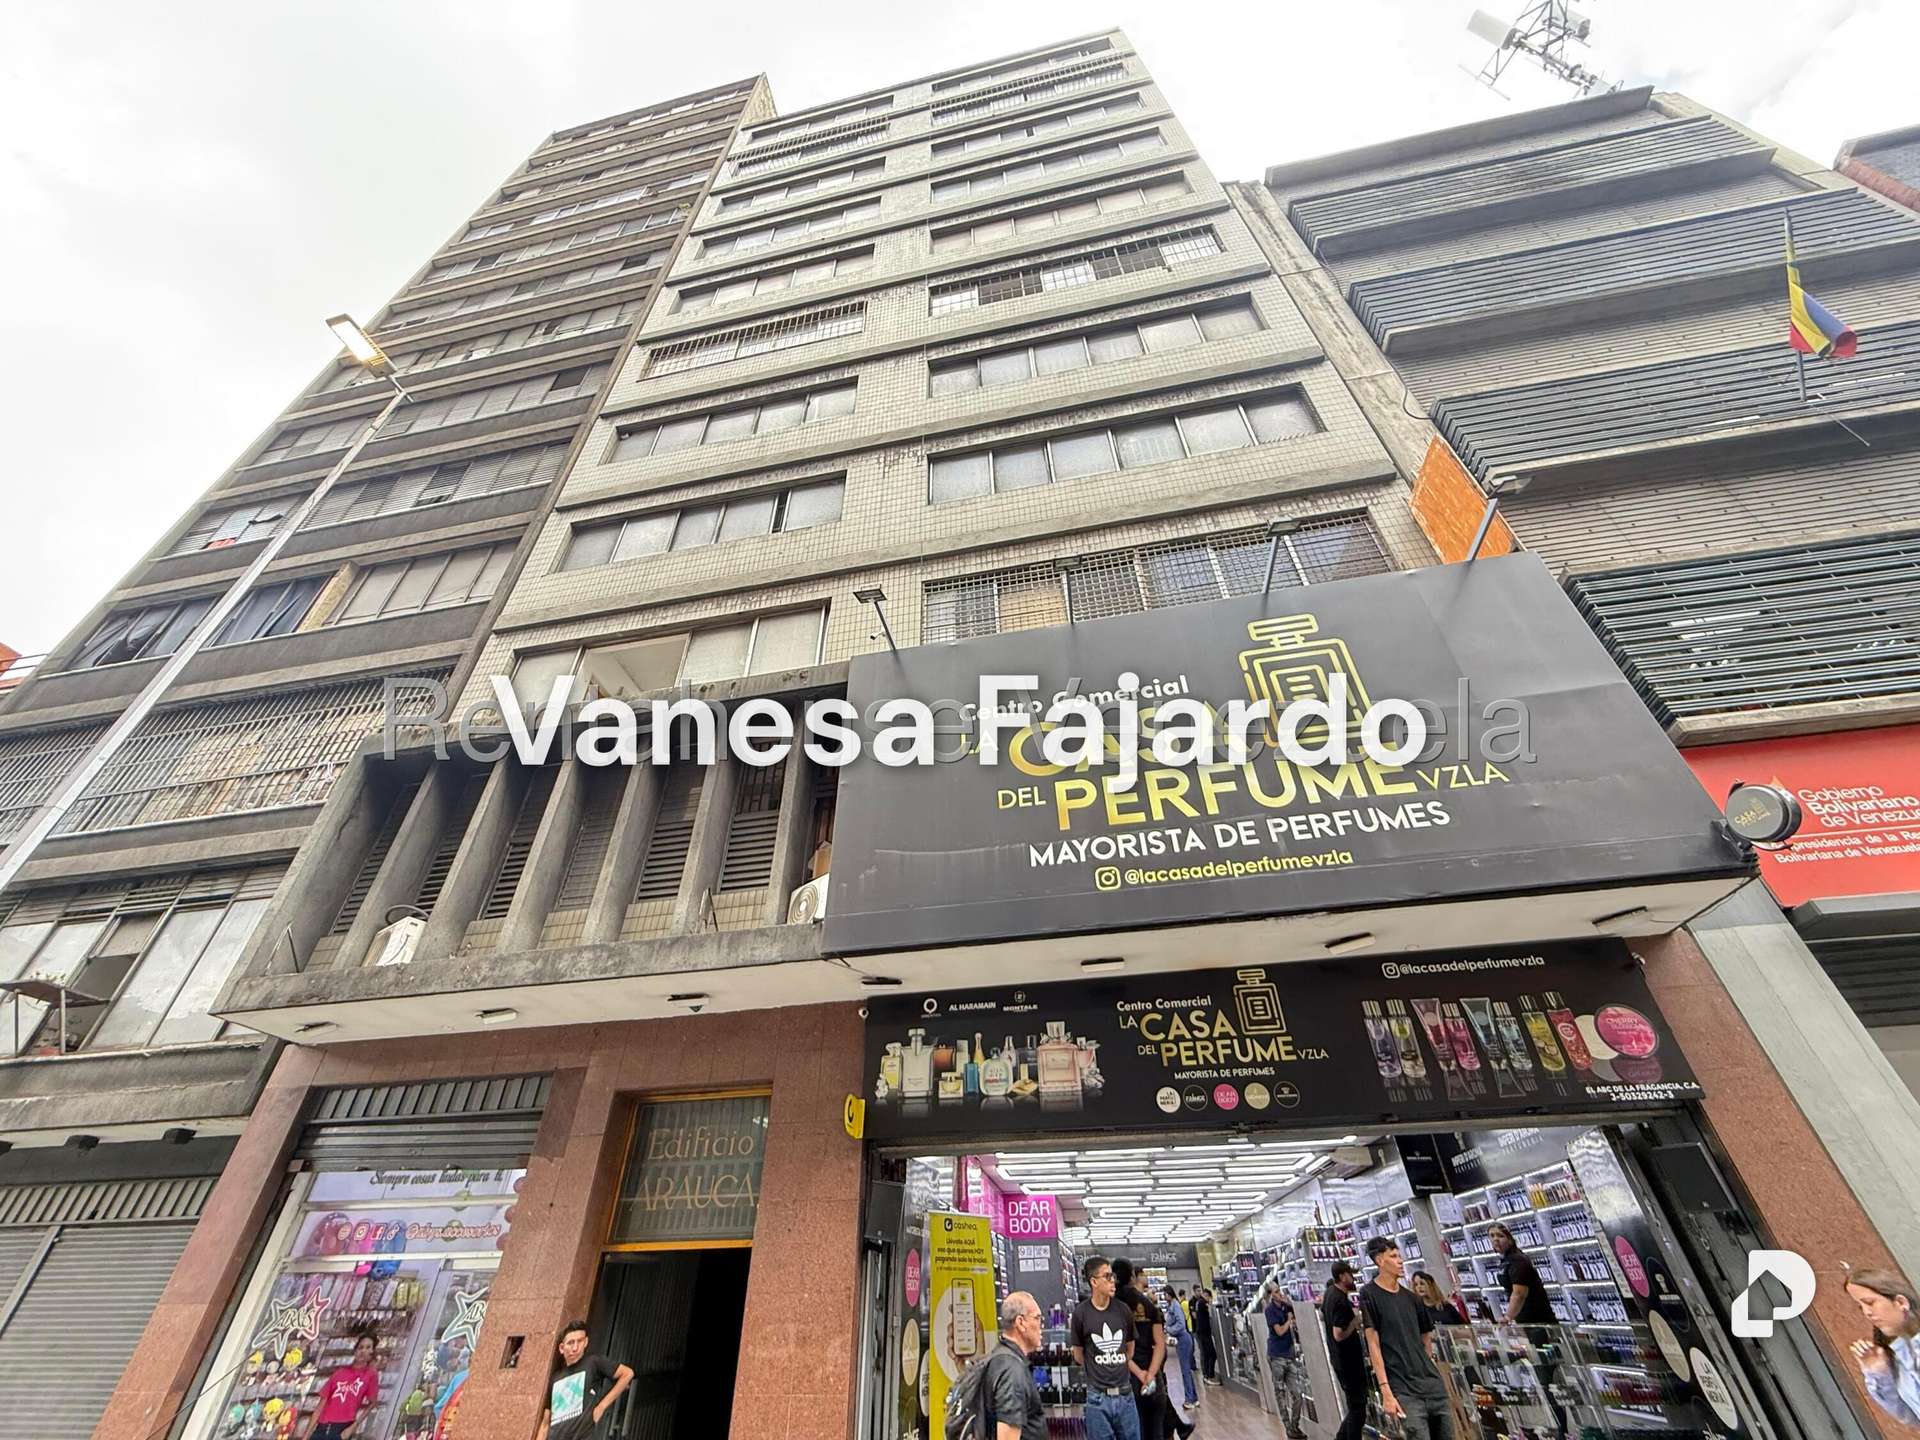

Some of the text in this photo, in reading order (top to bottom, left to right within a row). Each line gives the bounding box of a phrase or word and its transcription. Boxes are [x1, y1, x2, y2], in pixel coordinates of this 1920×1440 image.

[1052, 674, 1190, 710] Comercial
[996, 740, 1510, 831] DEL PERFUME VZLA
[1797, 785, 1883, 802] Gobierno
[1806, 796, 1920, 816] Bolivariano
[1820, 813, 1847, 828] de
[1029, 801, 1451, 867] MAYORISTA DE PERFUMES
[1864, 834, 1883, 844] de
[1883, 832, 1899, 842] la
[1774, 849, 1844, 864] Bolivariana
[1843, 847, 1862, 857] de
[1124, 849, 1354, 885] @lacasadelperfumevzla
[1399, 955, 1545, 975] @lacasadelperfumevzla
[1116, 995, 1212, 1012] Centro Comercial
[1119, 1009, 1237, 1041] LA CASA
[1137, 1036, 1329, 1067] DEL PERFUME VZLA
[1174, 1067, 1275, 1080] MAYORISTA DE PERFUMES
[648, 1126, 754, 1160] Edificio
[629, 1172, 756, 1211] ARAUCA
[1008, 1200, 1050, 1216] DEAR
[1009, 1217, 1051, 1233] BODY
[1095, 1350, 1127, 1365] adidas
